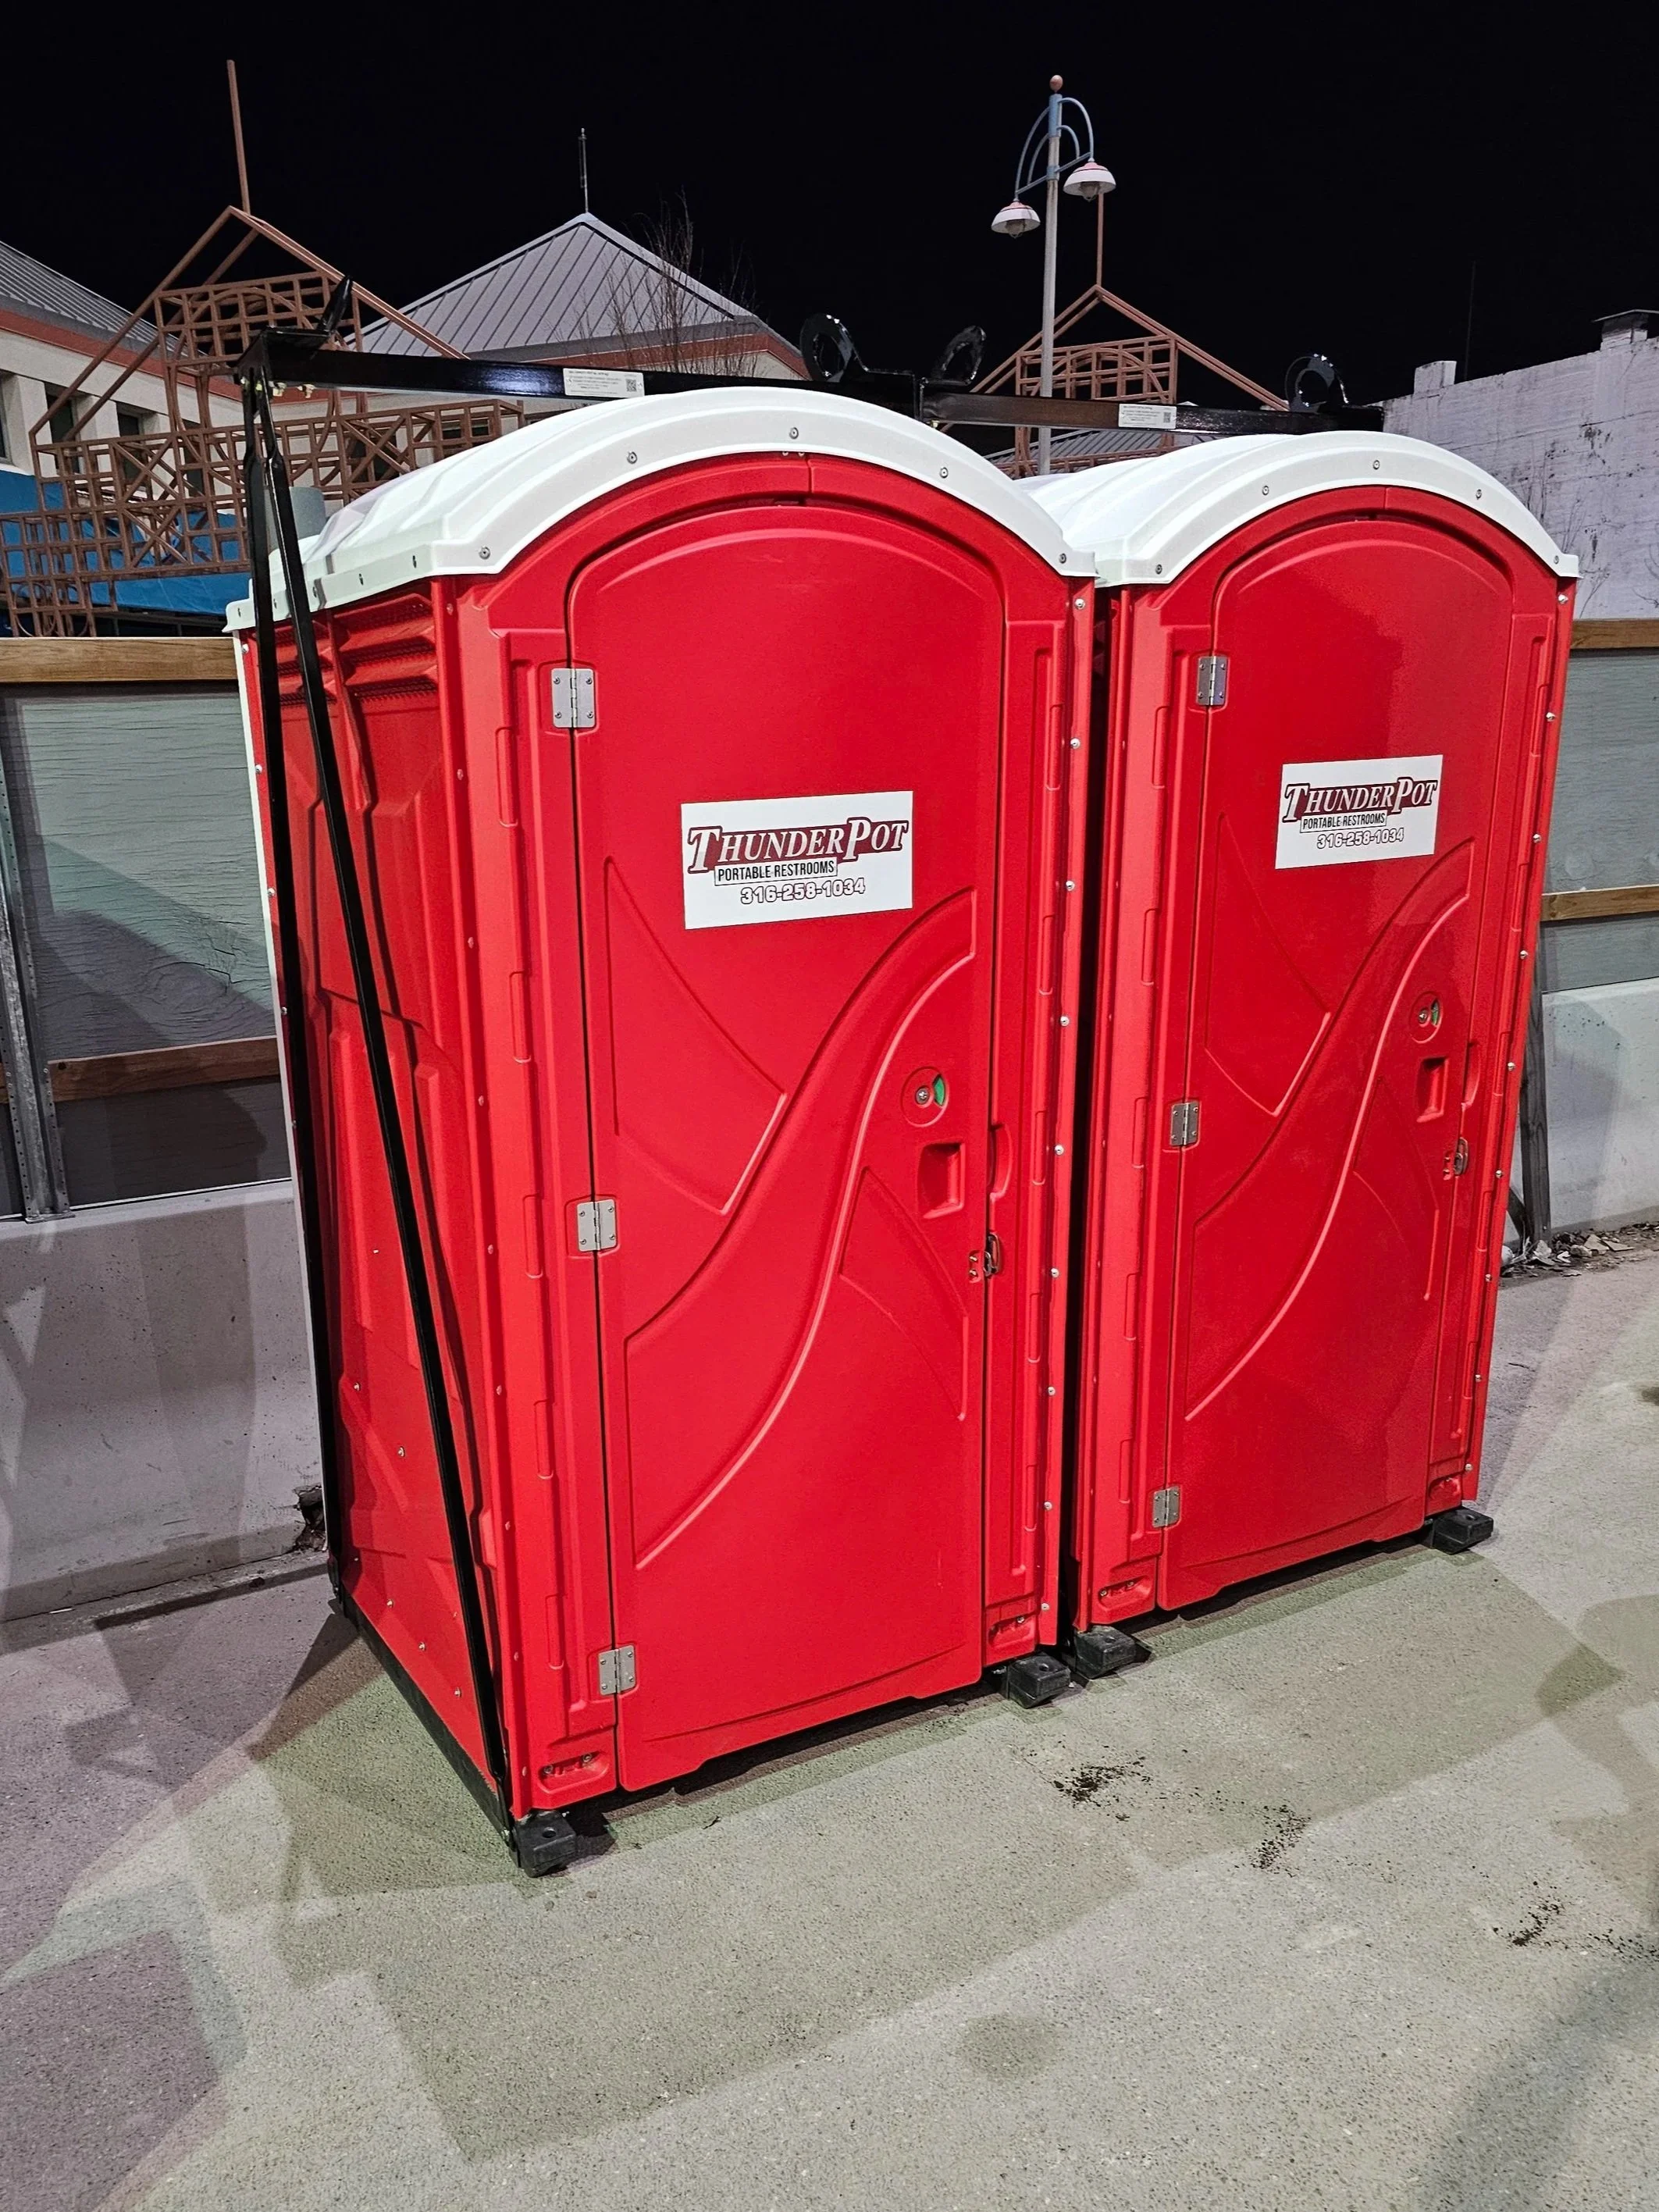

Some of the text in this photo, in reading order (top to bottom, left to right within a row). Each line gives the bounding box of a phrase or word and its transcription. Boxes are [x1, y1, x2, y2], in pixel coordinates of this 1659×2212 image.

[1303, 813, 1386, 829] PORTABLE RESTROOMS
[1317, 828, 1404, 849] 316-258-1034
[718, 860, 835, 882] PORTABLE RESTROOMS
[740, 878, 866, 904] 316-258-1034
